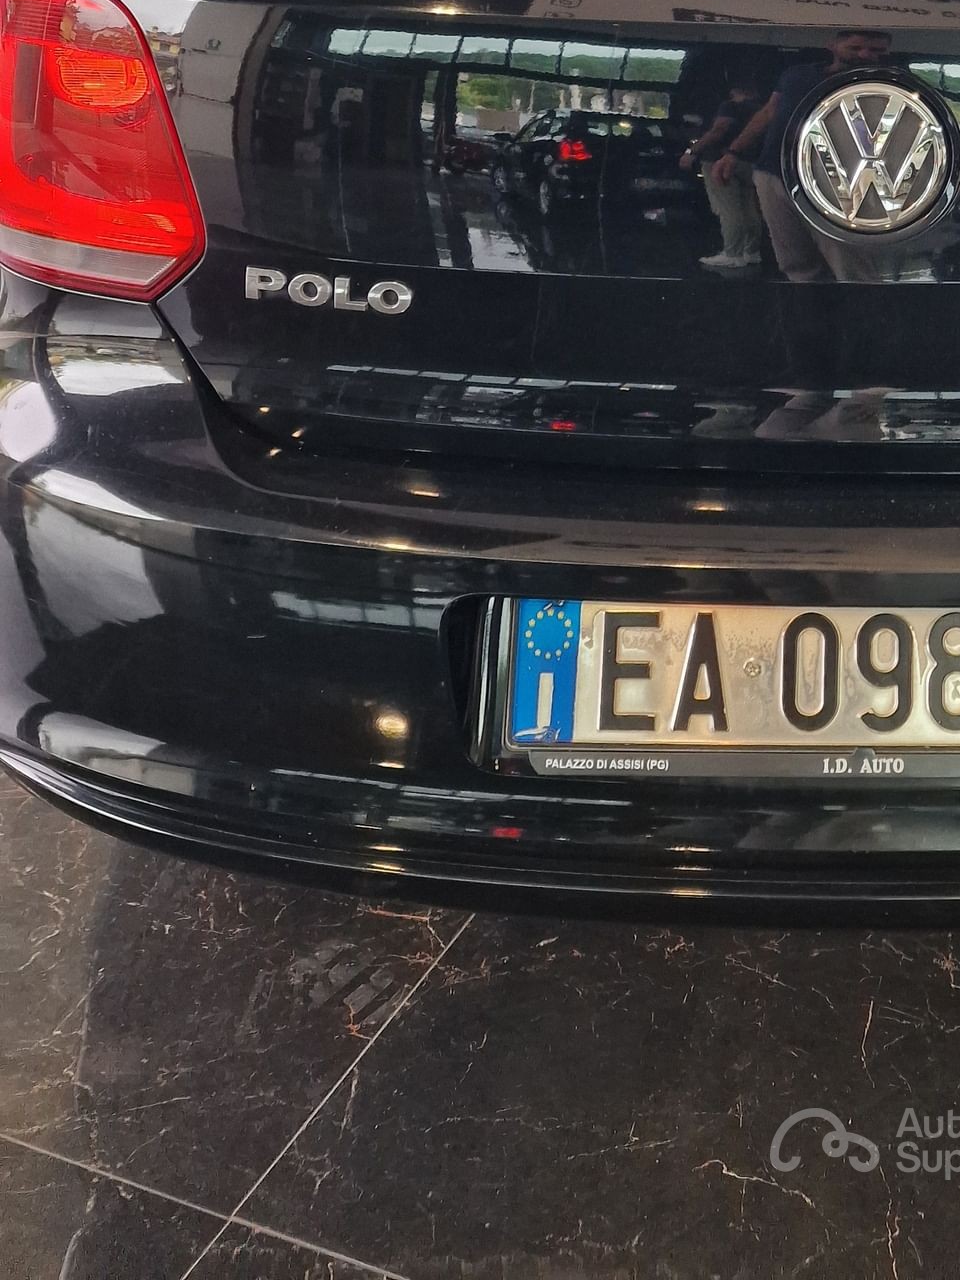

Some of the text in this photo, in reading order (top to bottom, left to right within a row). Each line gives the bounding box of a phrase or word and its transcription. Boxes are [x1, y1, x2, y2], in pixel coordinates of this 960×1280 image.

[245, 265, 412, 315] POLO
[545, 757, 669, 771] PALAZZO DI ASSISI (PG)
[823, 757, 905, 774] I.D. AUTO
